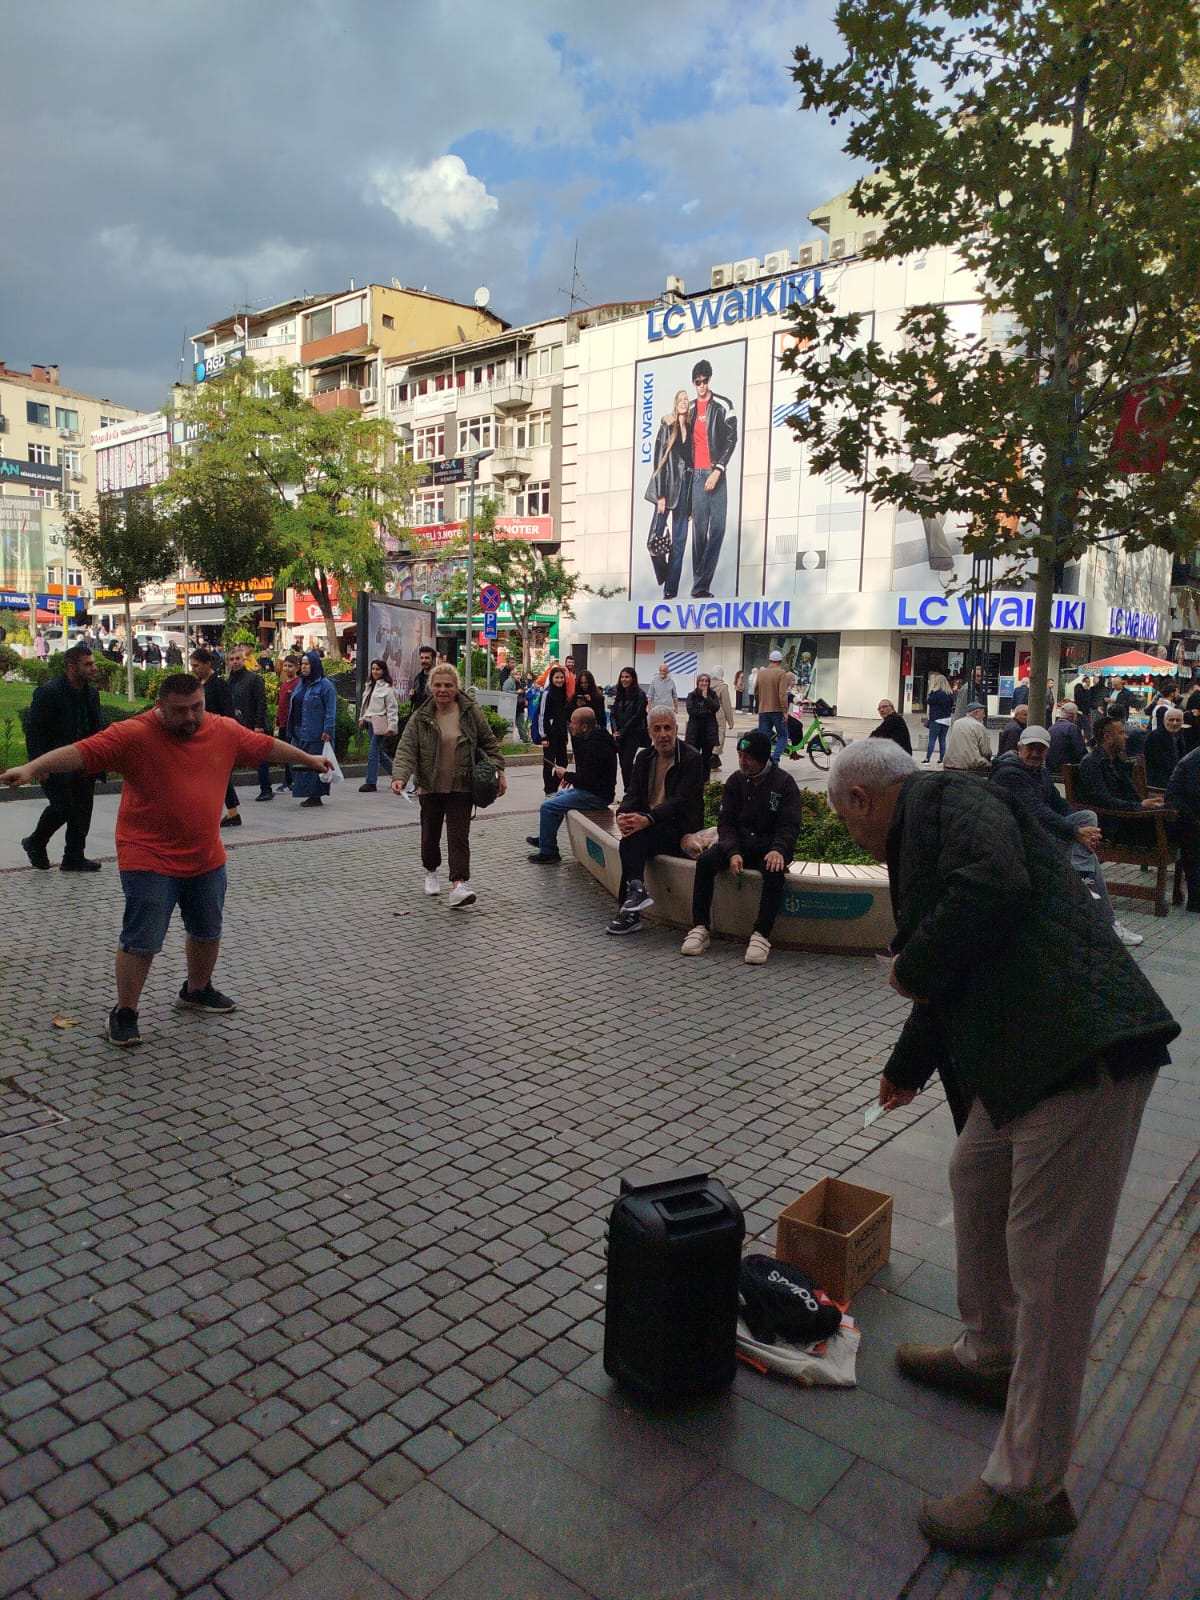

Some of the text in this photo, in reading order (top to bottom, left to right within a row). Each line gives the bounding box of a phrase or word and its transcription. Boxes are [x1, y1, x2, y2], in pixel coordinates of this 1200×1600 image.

[647, 305, 686, 342] LC
[641, 442, 652, 464] LC
[487, 613, 494, 624] P
[638, 604, 671, 630] LC
[898, 596, 949, 626] LC
[1109, 608, 1123, 635] LC
